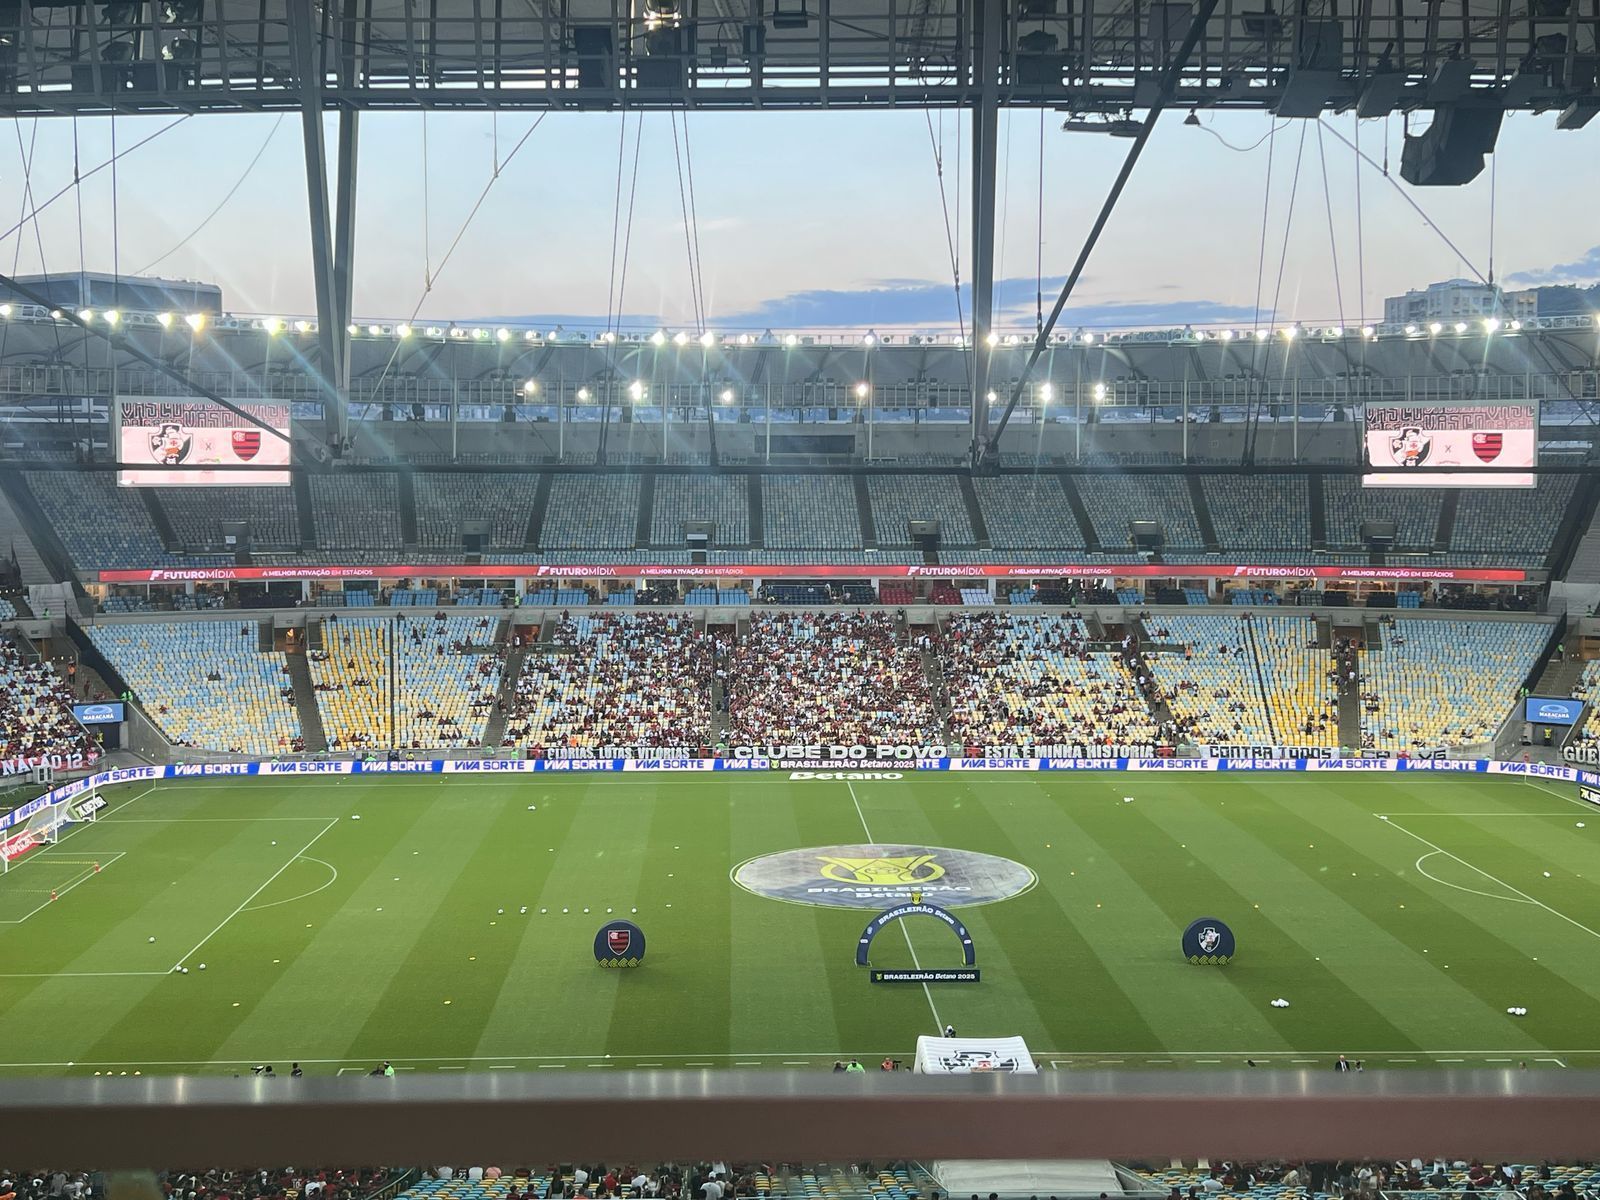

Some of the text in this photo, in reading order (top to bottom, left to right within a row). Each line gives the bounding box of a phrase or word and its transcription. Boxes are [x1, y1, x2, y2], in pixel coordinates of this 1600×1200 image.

[163, 569, 236, 580] FUTUROMÍDIA
[550, 567, 616, 576] FUTUROMÍDIA
[920, 567, 985, 576] FUTUROMÍDIA
[1246, 568, 1315, 577] FUTUROMÍDIA
[734, 745, 947, 758] CLUBE DO POVO
[984, 745, 1020, 758] ESTA
[1035, 745, 1082, 758] MINHA
[1210, 746, 1272, 759] CONTRA
[1563, 745, 1600, 764] GUE
[66, 754, 83, 769] 12
[390, 761, 432, 771] SORTE
[483, 761, 525, 770] SORTE
[572, 760, 613, 770] SORTE
[663, 760, 705, 769] SORTE
[780, 759, 915, 769] BRASILEIRÃO Betano 2025
[916, 759, 939, 768] RTE
[989, 759, 1030, 768] SORTE
[1077, 759, 1117, 768] SORTE
[1167, 759, 1208, 768] SORTE
[1255, 759, 1296, 769] SORTE
[1346, 760, 1387, 769] SORTE
[1434, 760, 1477, 770] SORTE
[204, 763, 248, 774] SORTE
[300, 762, 342, 772] SORTE
[1530, 765, 1570, 777] SORTE
[112, 767, 155, 780] SORTE
[789, 772, 903, 780] Betano
[878, 905, 934, 925] BRASILEIRÃO
